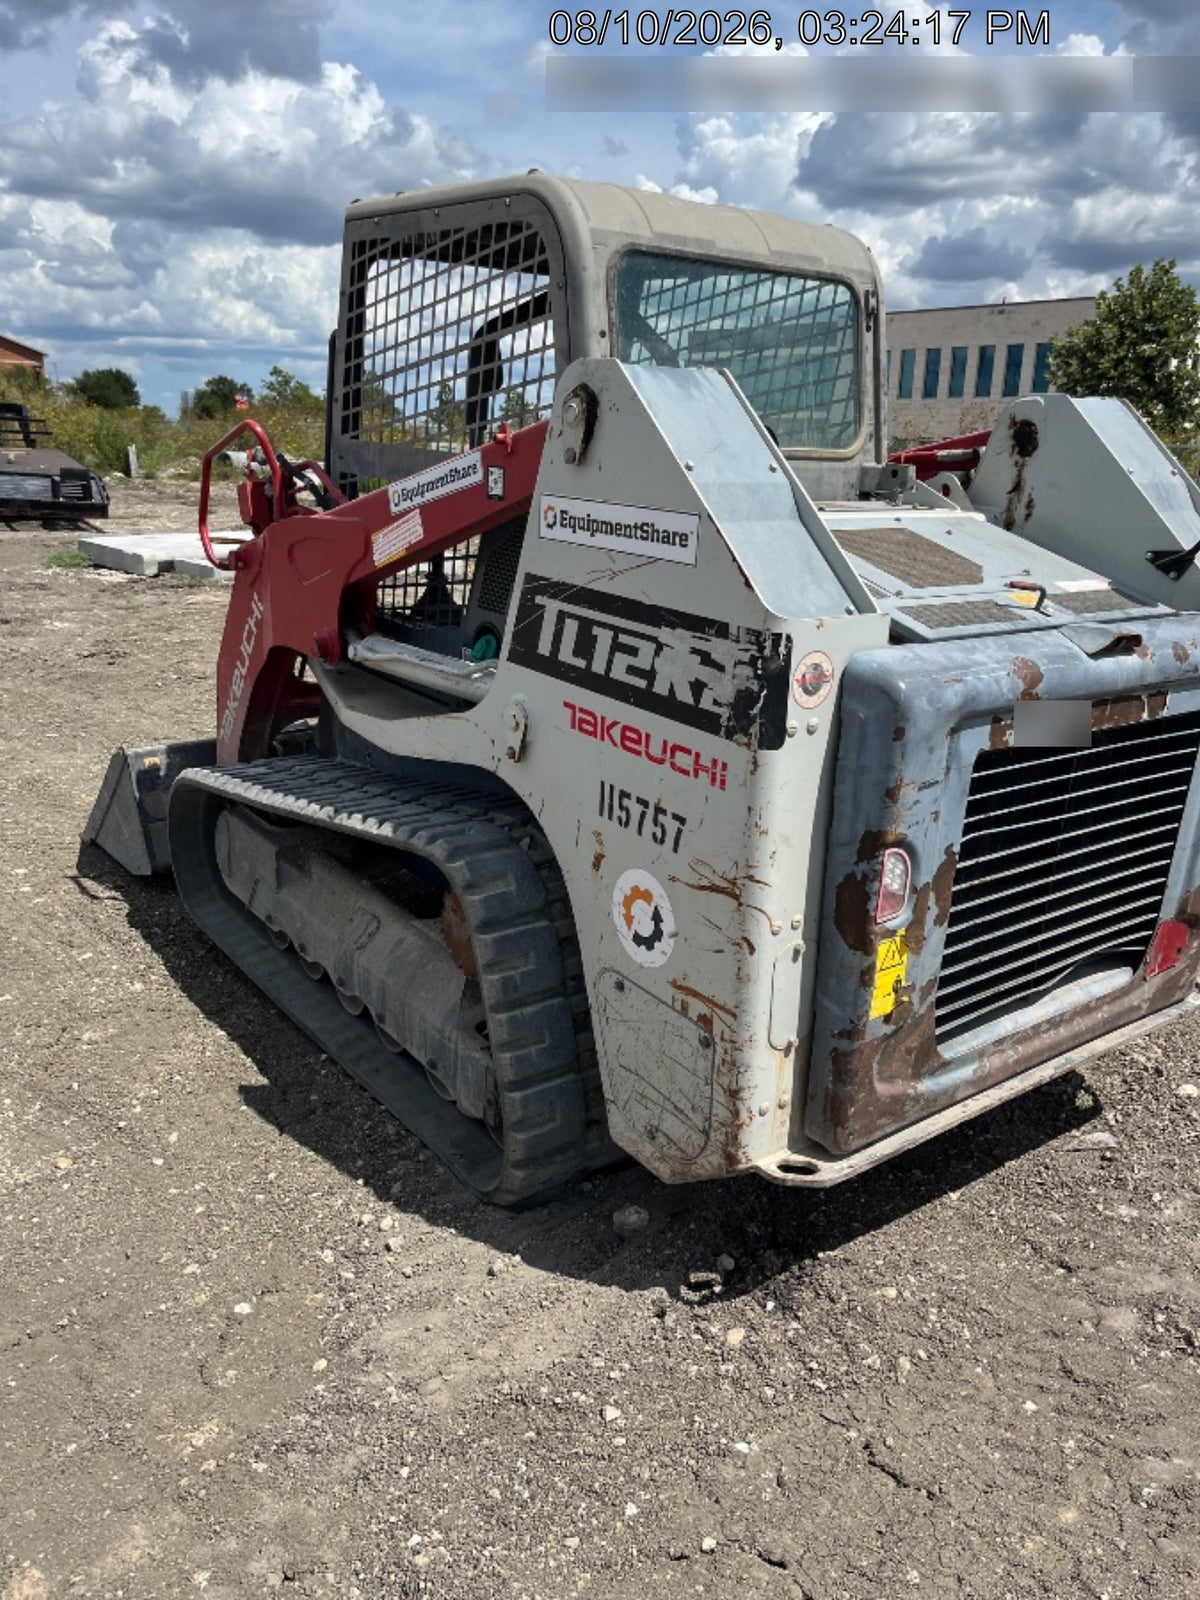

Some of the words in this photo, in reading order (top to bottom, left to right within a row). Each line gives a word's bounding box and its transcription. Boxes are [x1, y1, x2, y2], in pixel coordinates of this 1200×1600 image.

[401, 464, 479, 502] EquipmentShare
[559, 509, 690, 548] EquipmentShare
[598, 780, 687, 854] 115757
